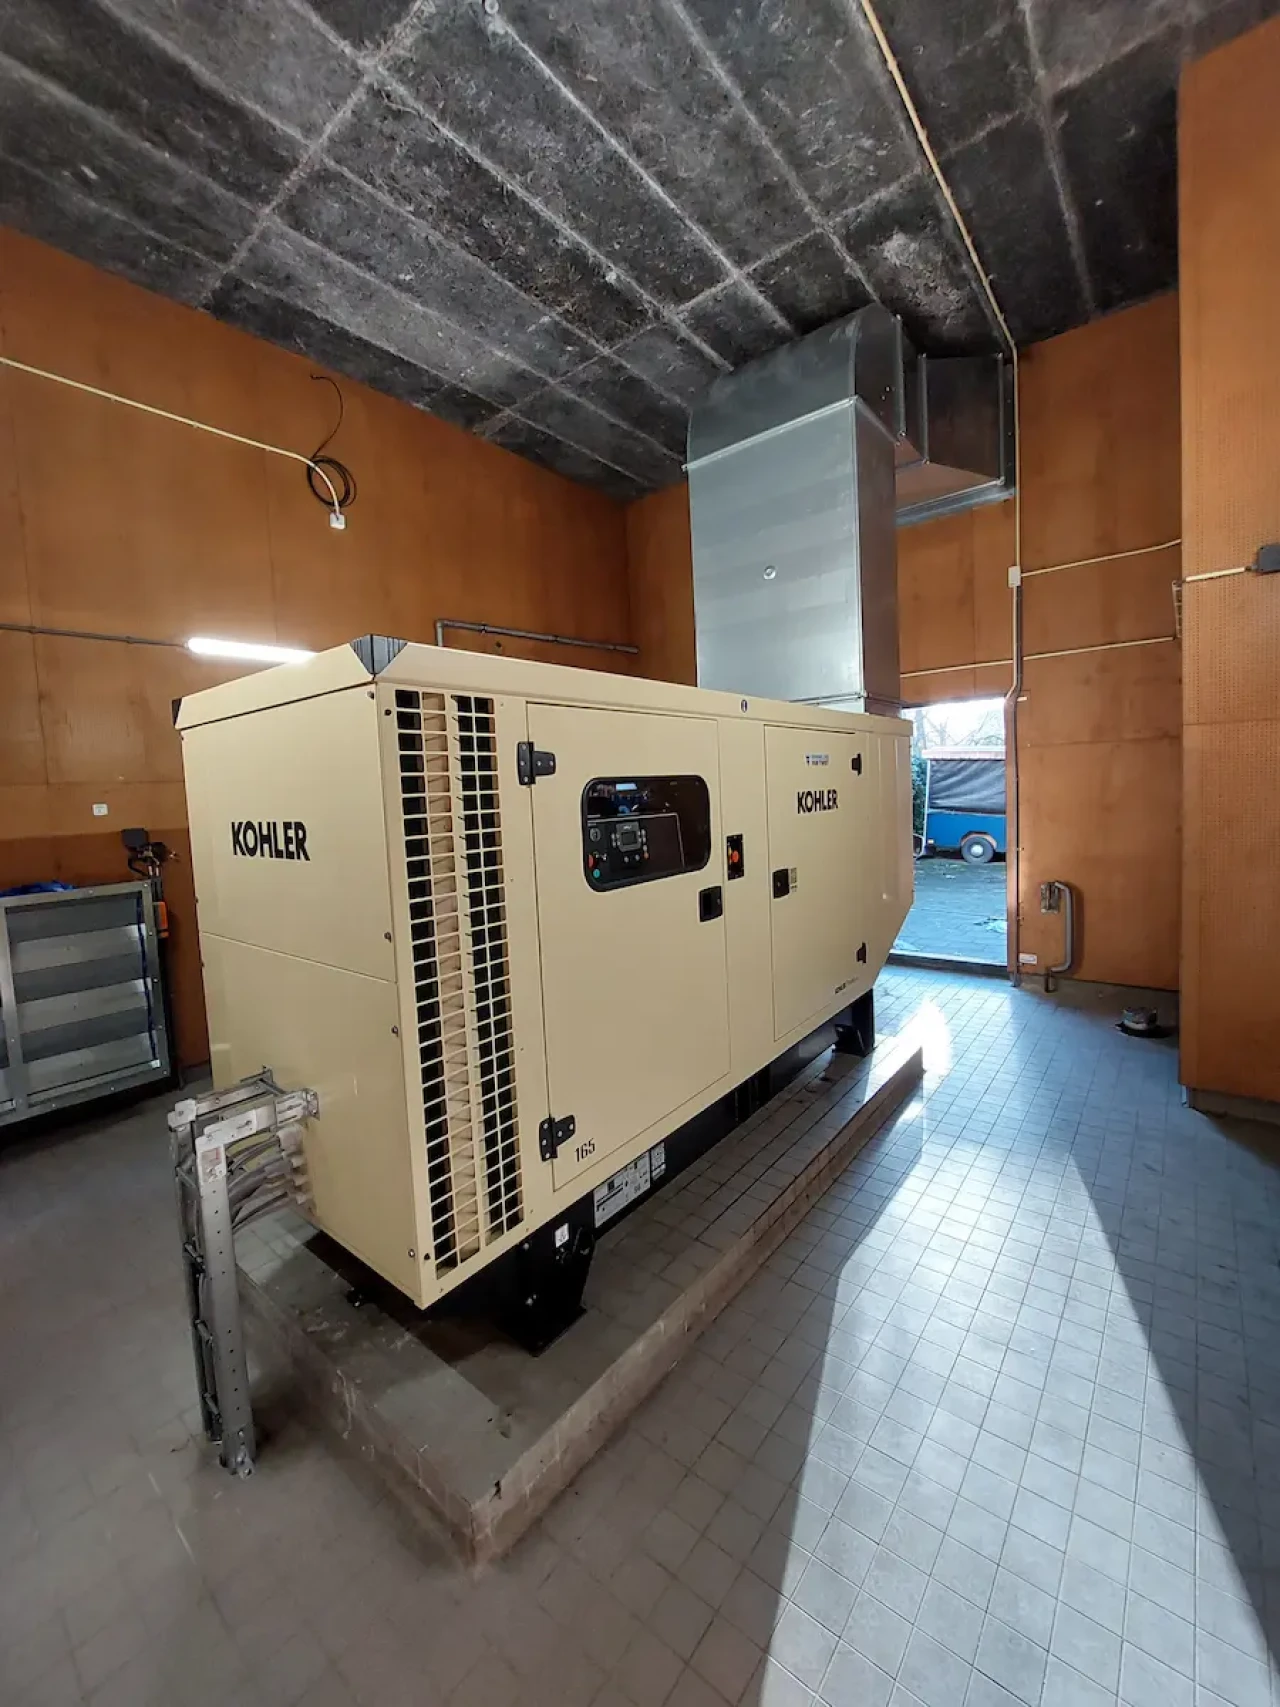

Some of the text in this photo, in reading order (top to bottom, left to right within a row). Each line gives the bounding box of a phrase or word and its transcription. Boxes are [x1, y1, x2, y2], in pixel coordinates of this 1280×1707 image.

[797, 789, 838, 814] KOHLER
[231, 820, 310, 861] KOHLER
[575, 1138, 596, 1162] 165
